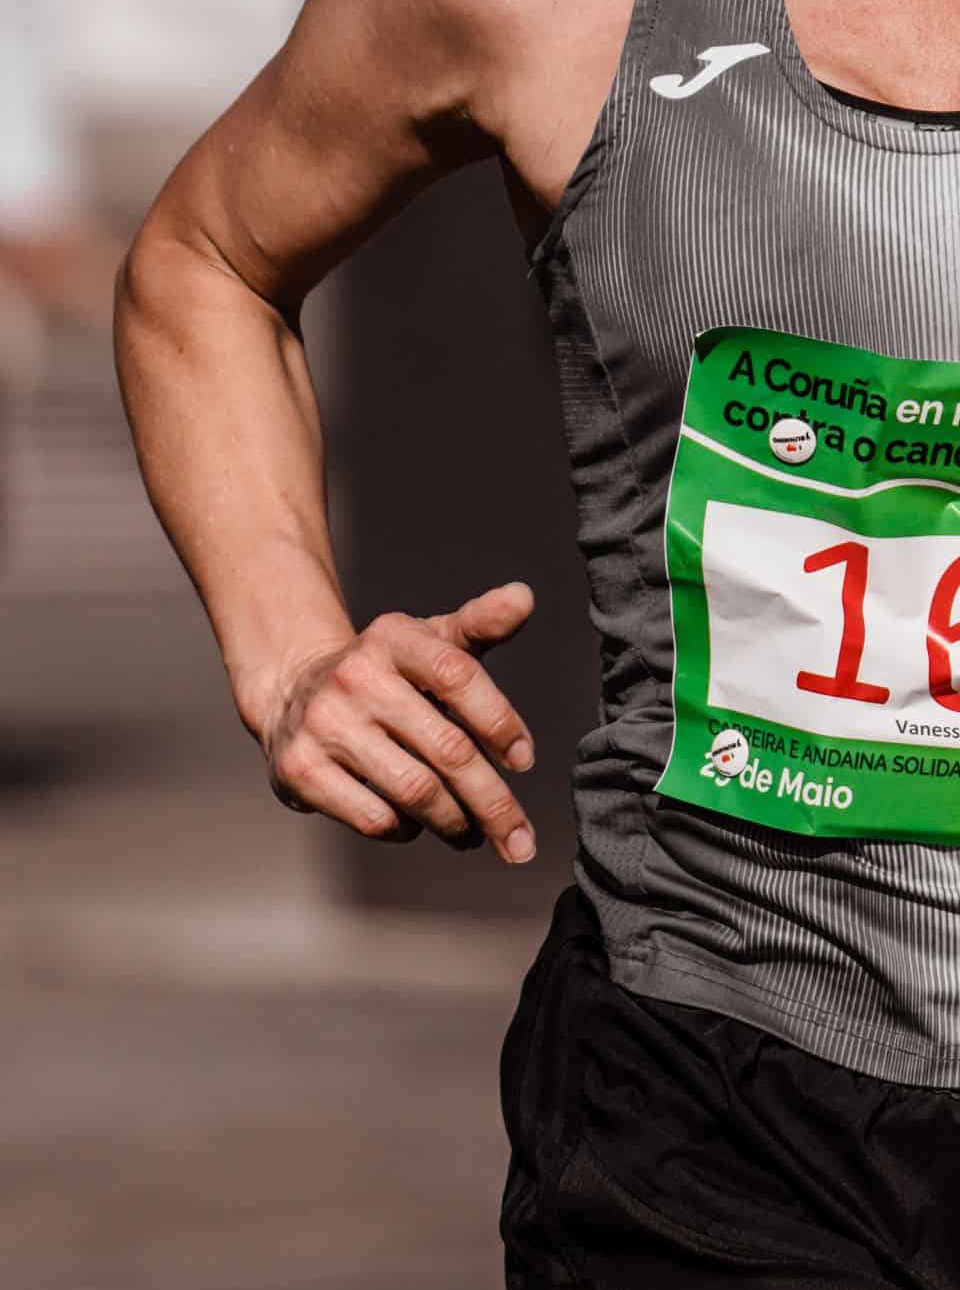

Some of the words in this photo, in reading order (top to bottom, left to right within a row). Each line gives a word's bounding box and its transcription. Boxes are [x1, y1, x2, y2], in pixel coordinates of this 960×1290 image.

[728, 350, 756, 387] A
[764, 358, 888, 422] Coruña
[895, 398, 944, 426] en
[723, 400, 845, 453] cora
[853, 436, 877, 463] o
[739, 758, 774, 793] de
[776, 767, 854, 809] Maio
[789, 739, 802, 759] E
[802, 744, 888, 772] ANDAINA
